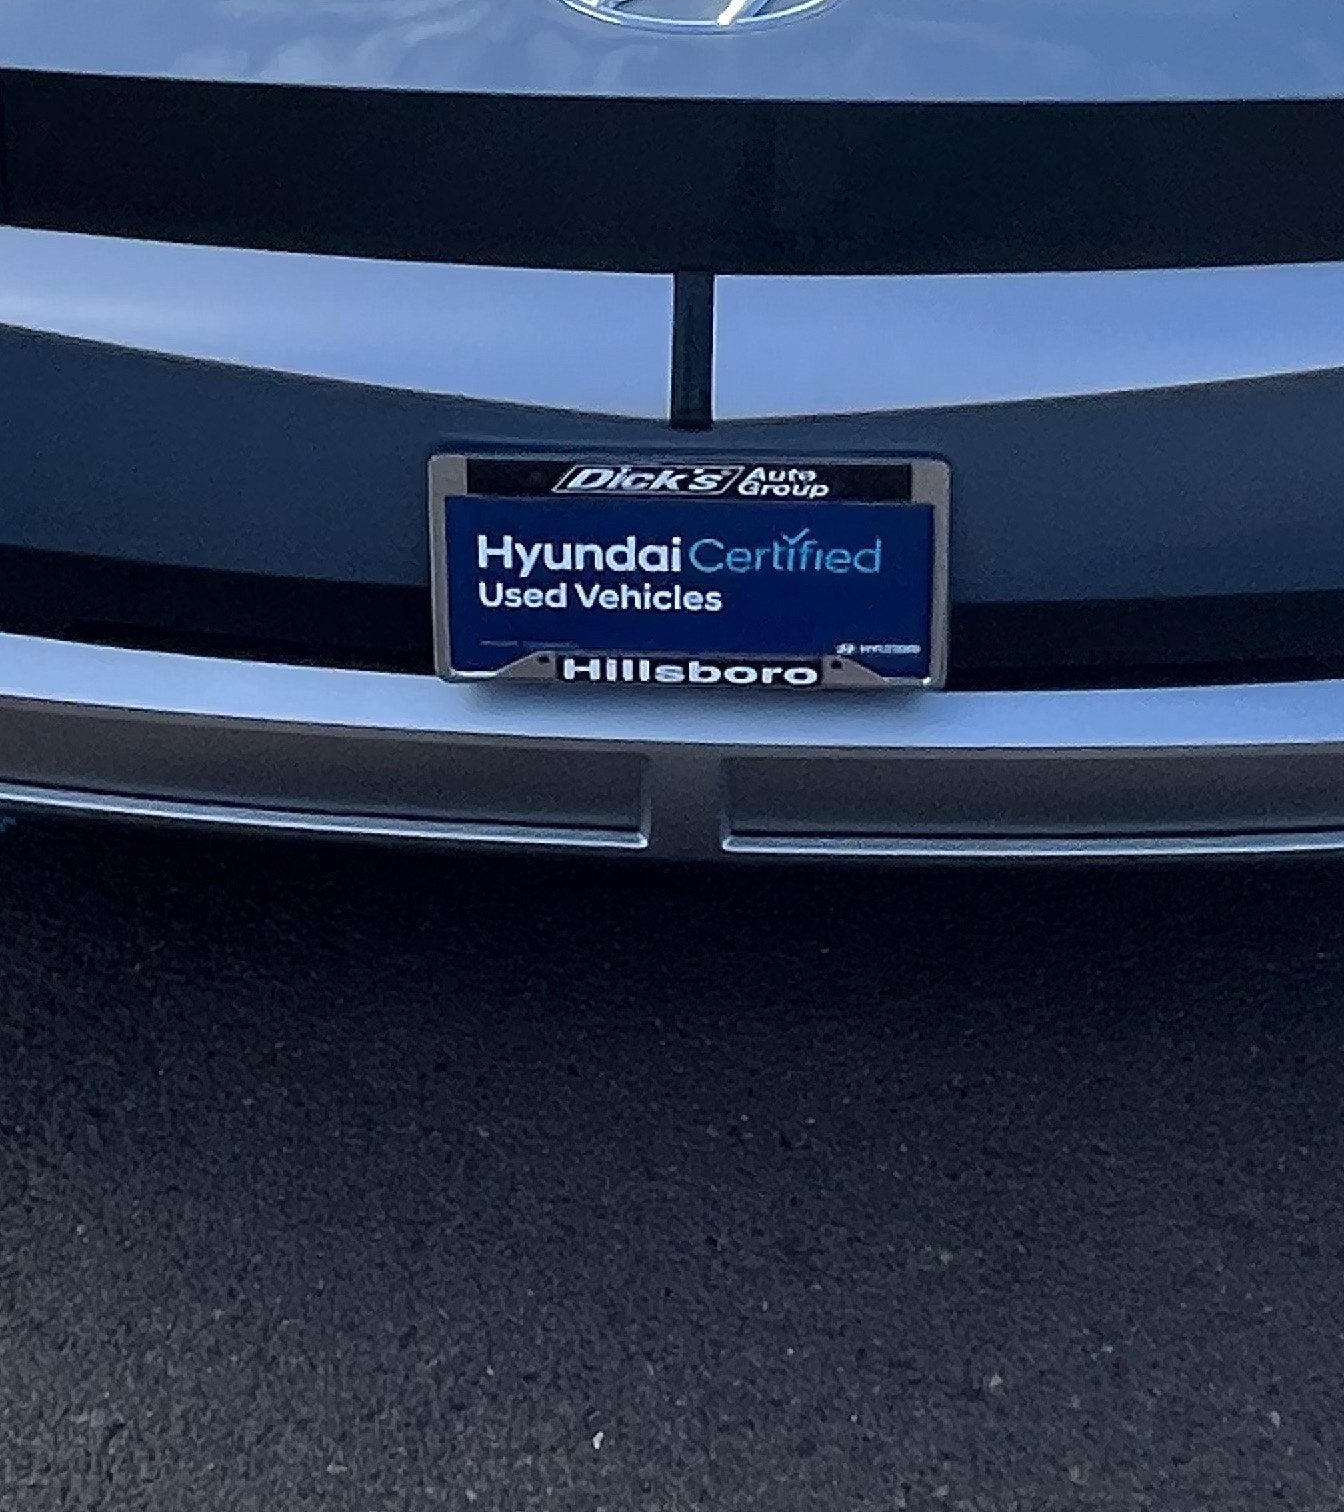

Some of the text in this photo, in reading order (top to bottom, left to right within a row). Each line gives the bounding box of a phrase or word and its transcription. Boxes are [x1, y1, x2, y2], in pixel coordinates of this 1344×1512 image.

[567, 466, 724, 491] Dick's
[749, 466, 817, 482] Auto
[737, 480, 830, 499] Group
[476, 528, 883, 578] Hyundai Certified
[477, 581, 723, 612] Used Vehicles
[562, 657, 819, 686] Hillsboro
